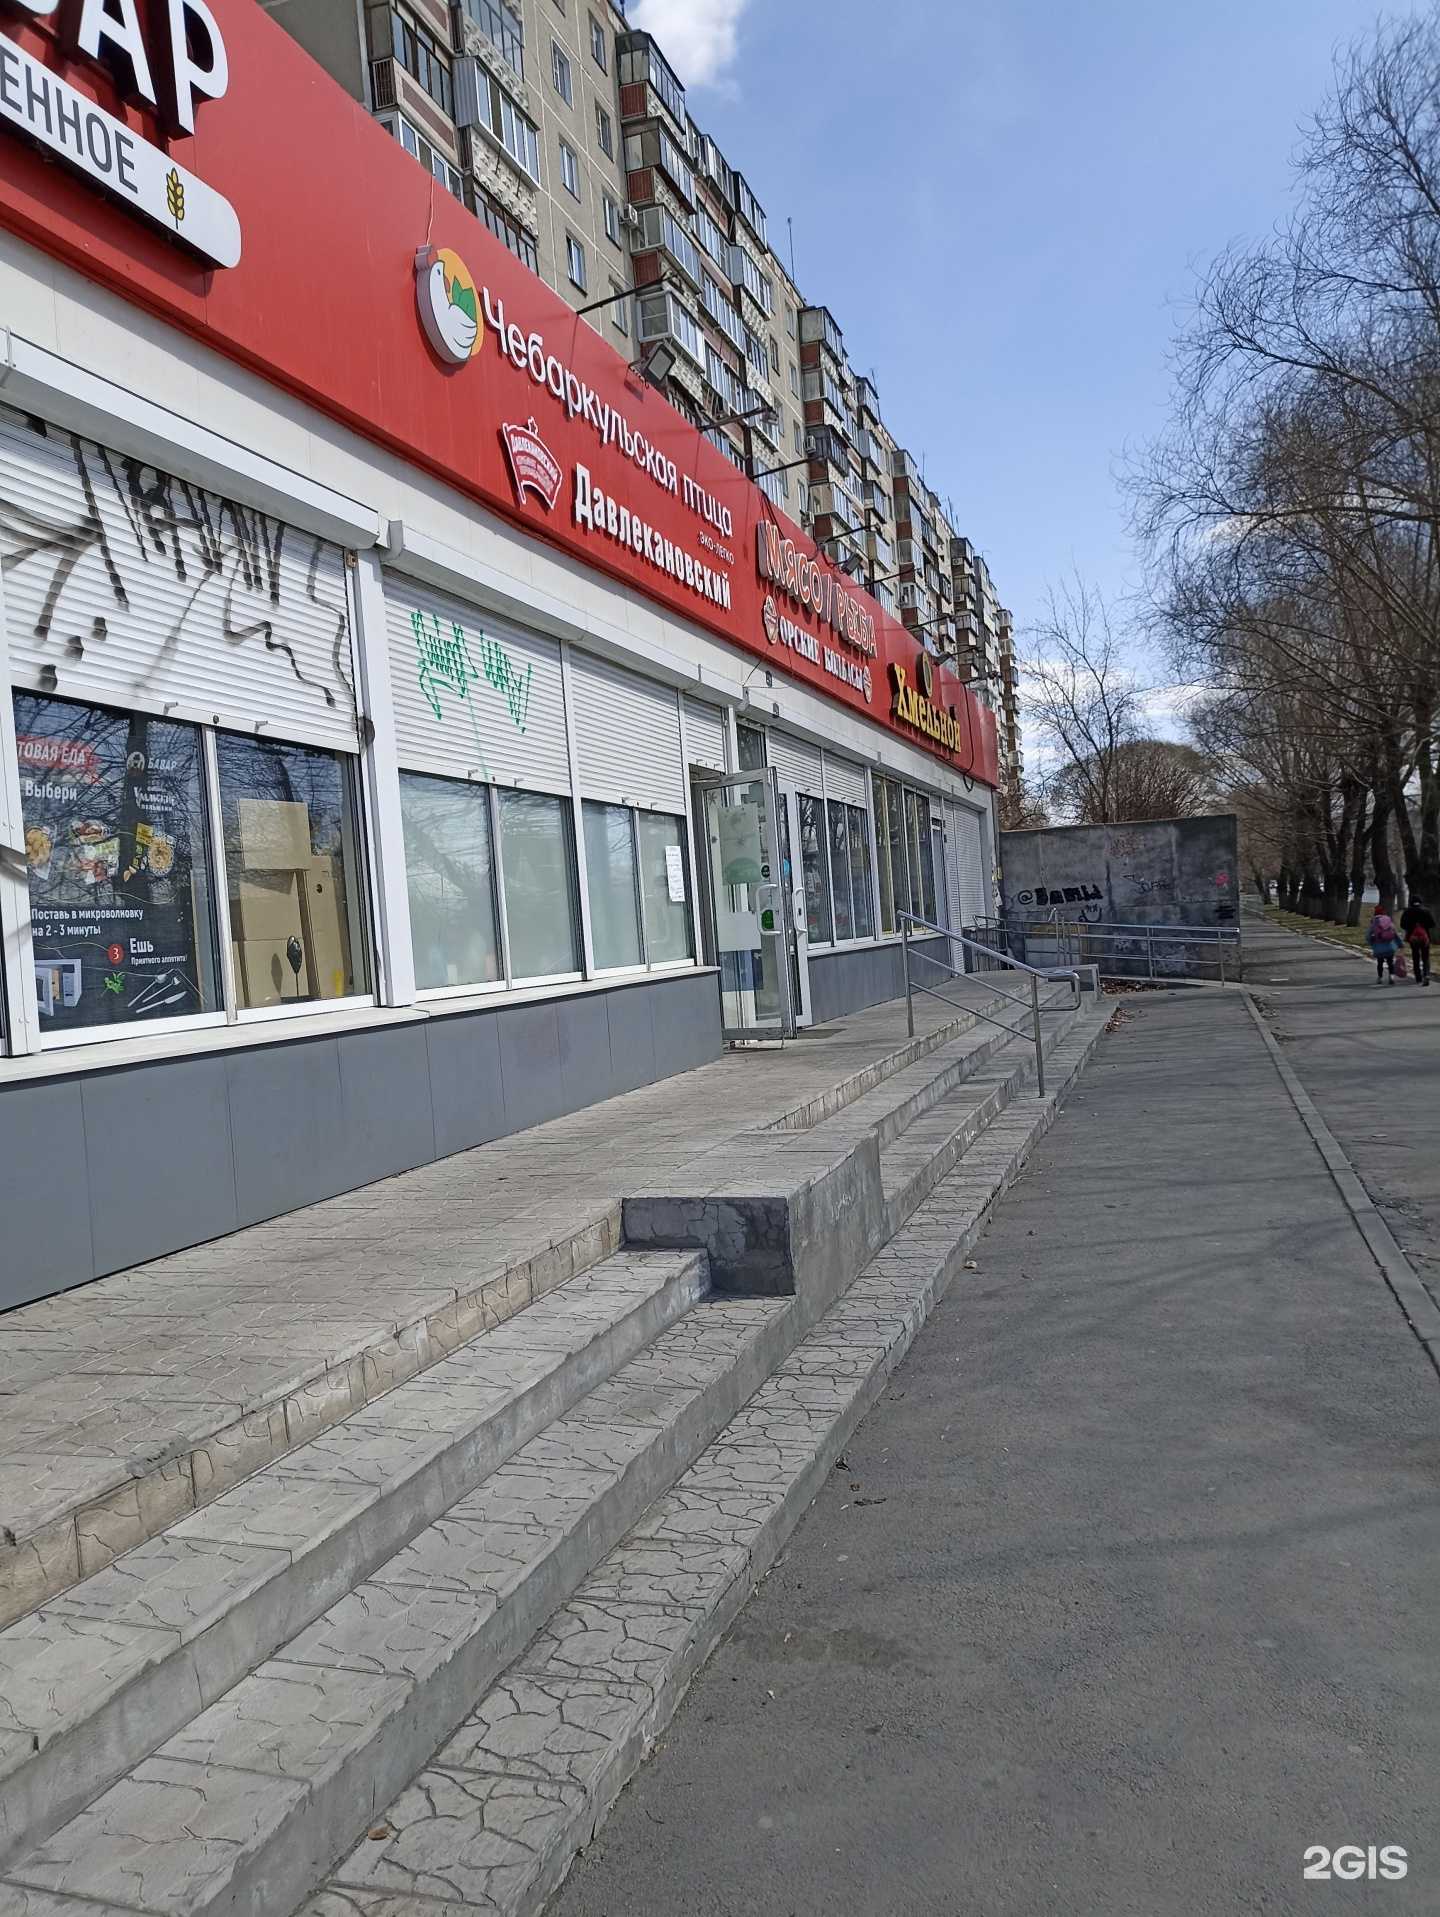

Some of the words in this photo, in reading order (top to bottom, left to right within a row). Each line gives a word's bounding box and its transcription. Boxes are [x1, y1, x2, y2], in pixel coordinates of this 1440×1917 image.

[14, 0, 229, 135] АР
[482, 286, 678, 496] Чебаркульская
[682, 473, 734, 538] птица
[576, 463, 732, 610] Давлекановский
[779, 615, 821, 665] ОРСКИЕ
[894, 662, 962, 753] Хмельной
[25, 780, 78, 803] Выбери
[31, 908, 70, 920] Поставь
[72, 910, 77, 919] в
[79, 909, 144, 921] микроволновку
[32, 926, 44, 937] на
[46, 925, 52, 936] 2
[60, 924, 65, 936] 3
[67, 926, 101, 938] минуты
[113, 948, 120, 960] 3
[129, 937, 154, 954] Ешь
